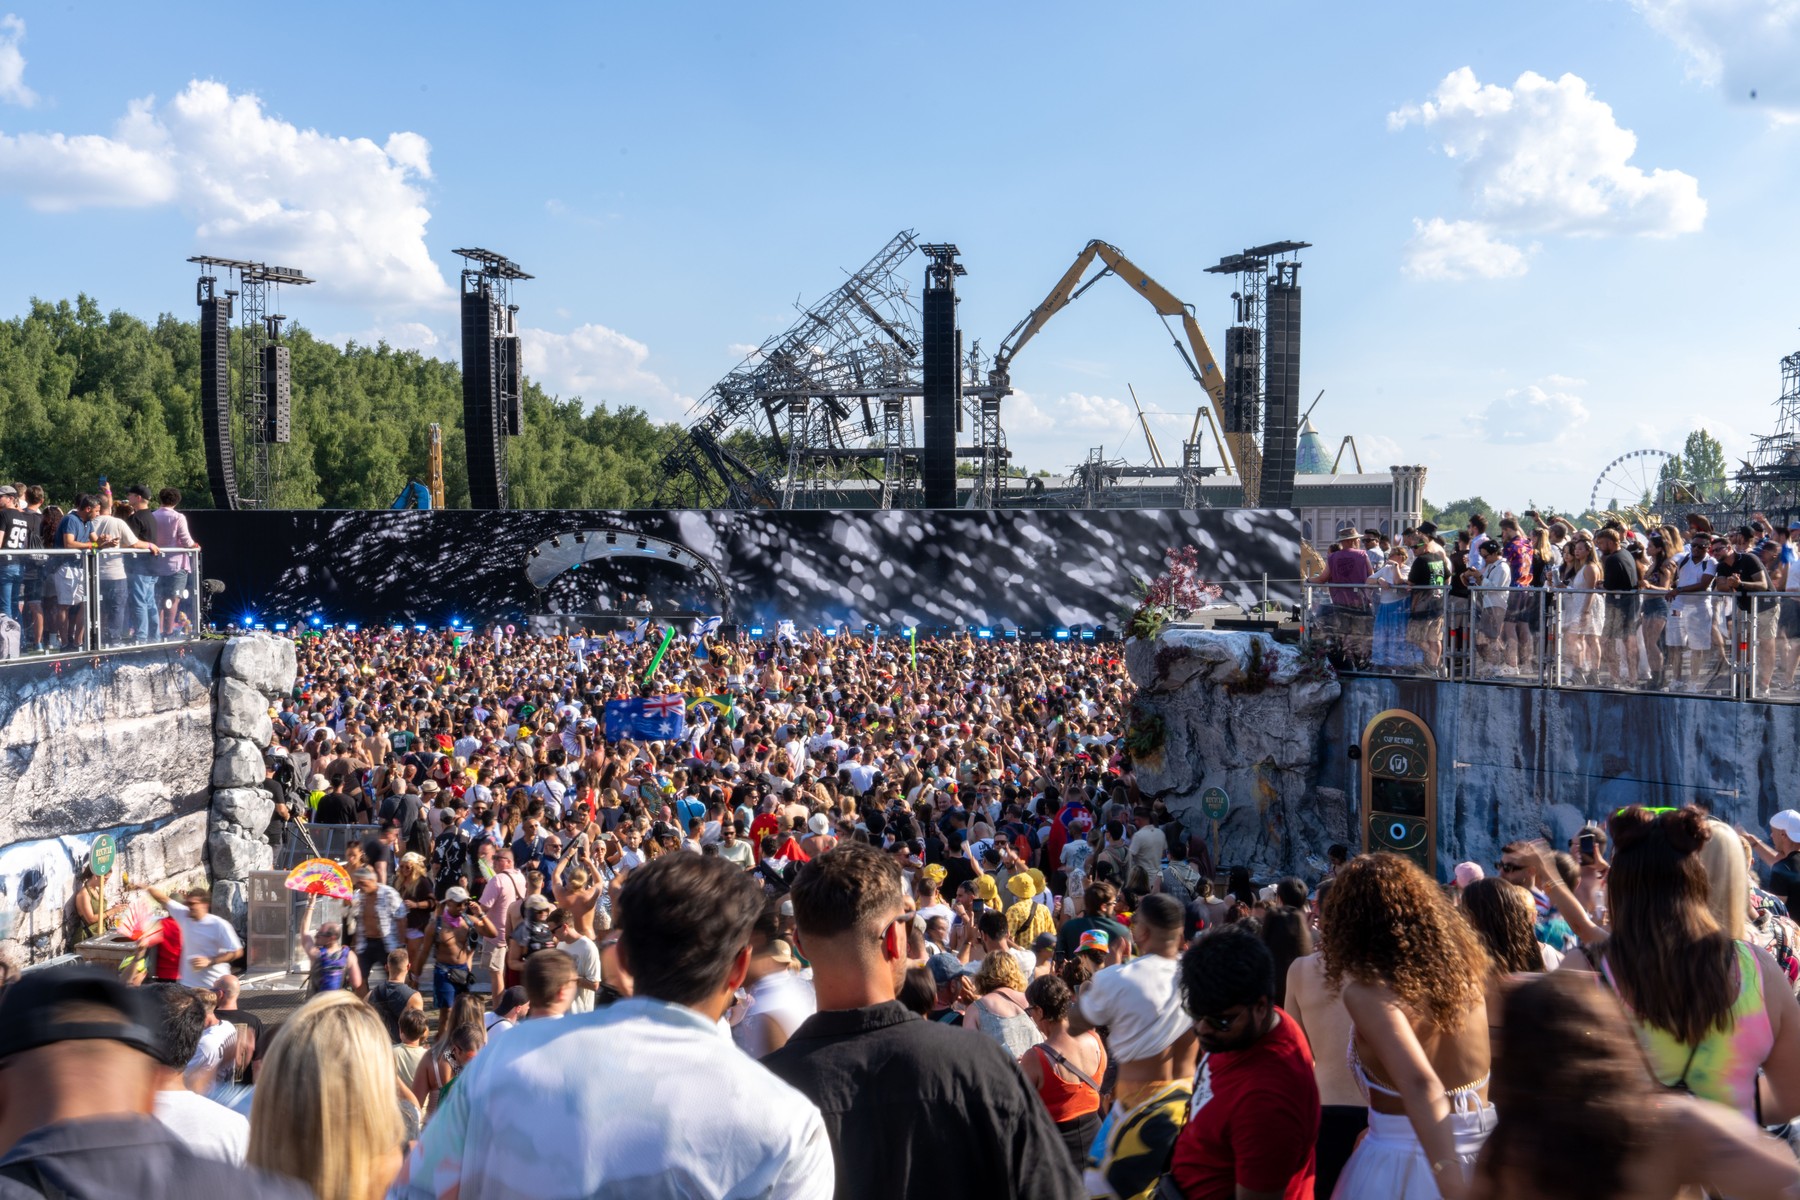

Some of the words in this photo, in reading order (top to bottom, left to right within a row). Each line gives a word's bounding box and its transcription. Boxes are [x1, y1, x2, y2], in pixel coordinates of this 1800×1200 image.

[7, 526, 28, 549] 99
[1383, 735, 1393, 744] CUP
[1393, 736, 1414, 745] RETURN
[1205, 796, 1225, 804] RECYCLE
[96, 846, 112, 857] RECYCLE
